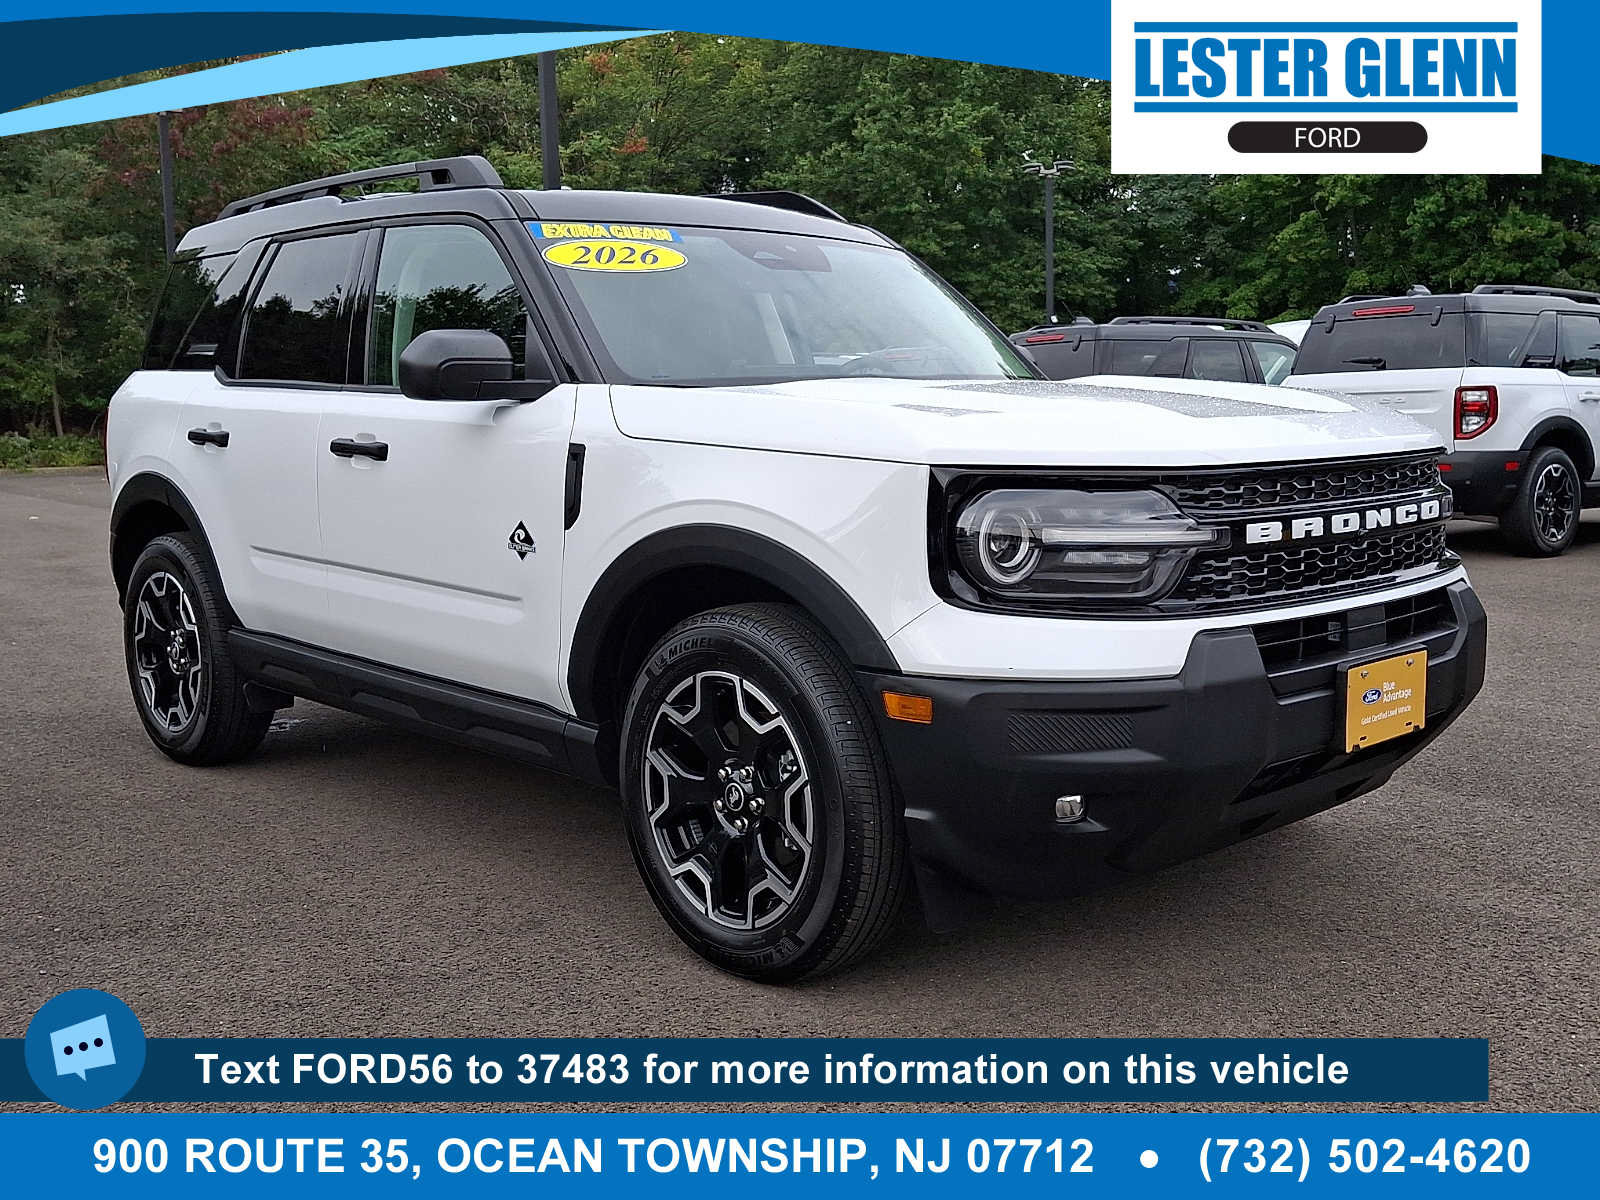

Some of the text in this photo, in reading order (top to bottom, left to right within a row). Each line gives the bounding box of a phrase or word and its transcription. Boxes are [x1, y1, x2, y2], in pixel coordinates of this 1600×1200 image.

[541, 223, 673, 241] EXTRA CLEAN
[571, 245, 659, 265] 2026
[1246, 500, 1440, 544] BRONCO
[1383, 681, 1396, 692] Blue
[1364, 690, 1380, 703] Ford
[1383, 688, 1412, 703] Advantage
